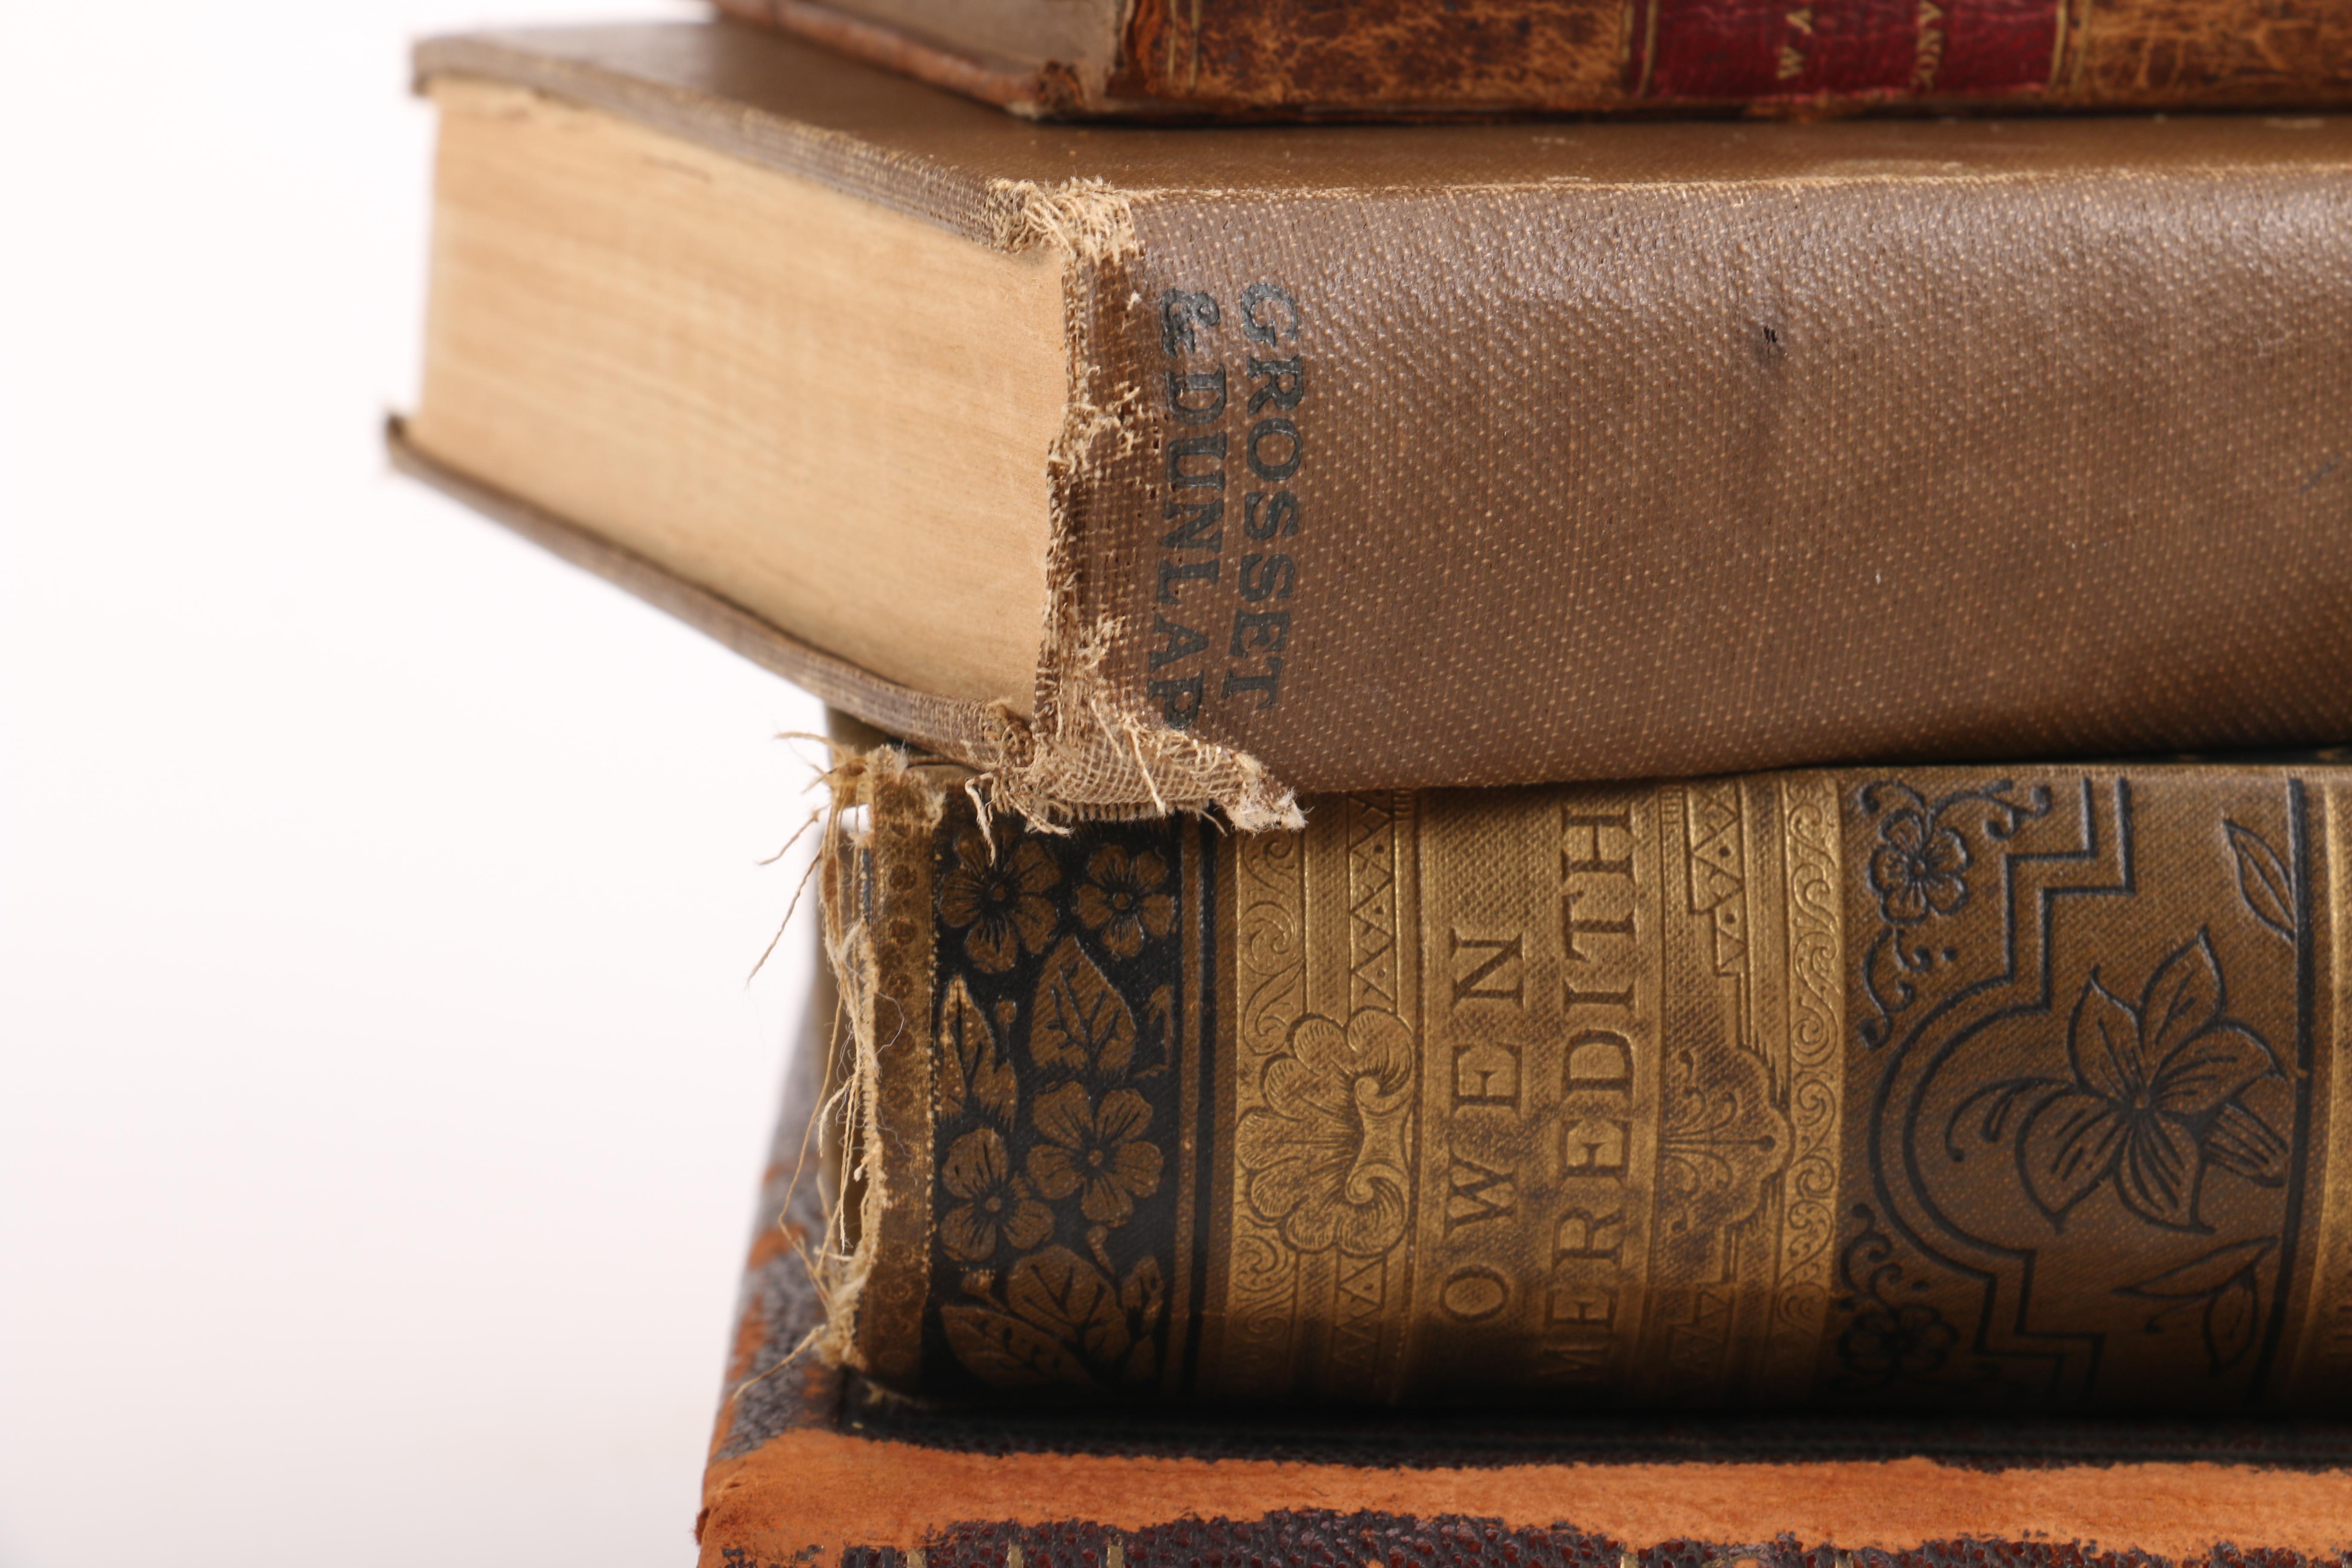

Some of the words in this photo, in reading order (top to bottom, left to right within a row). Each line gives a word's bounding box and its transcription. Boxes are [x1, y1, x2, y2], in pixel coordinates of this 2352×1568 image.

[1159, 287, 1220, 358] &
[1221, 282, 1305, 710] GROSSET
[1147, 362, 1228, 730] DUNLAP
[1439, 924, 1525, 1323] OWEN
[1538, 801, 1635, 1381] MEREDITH
